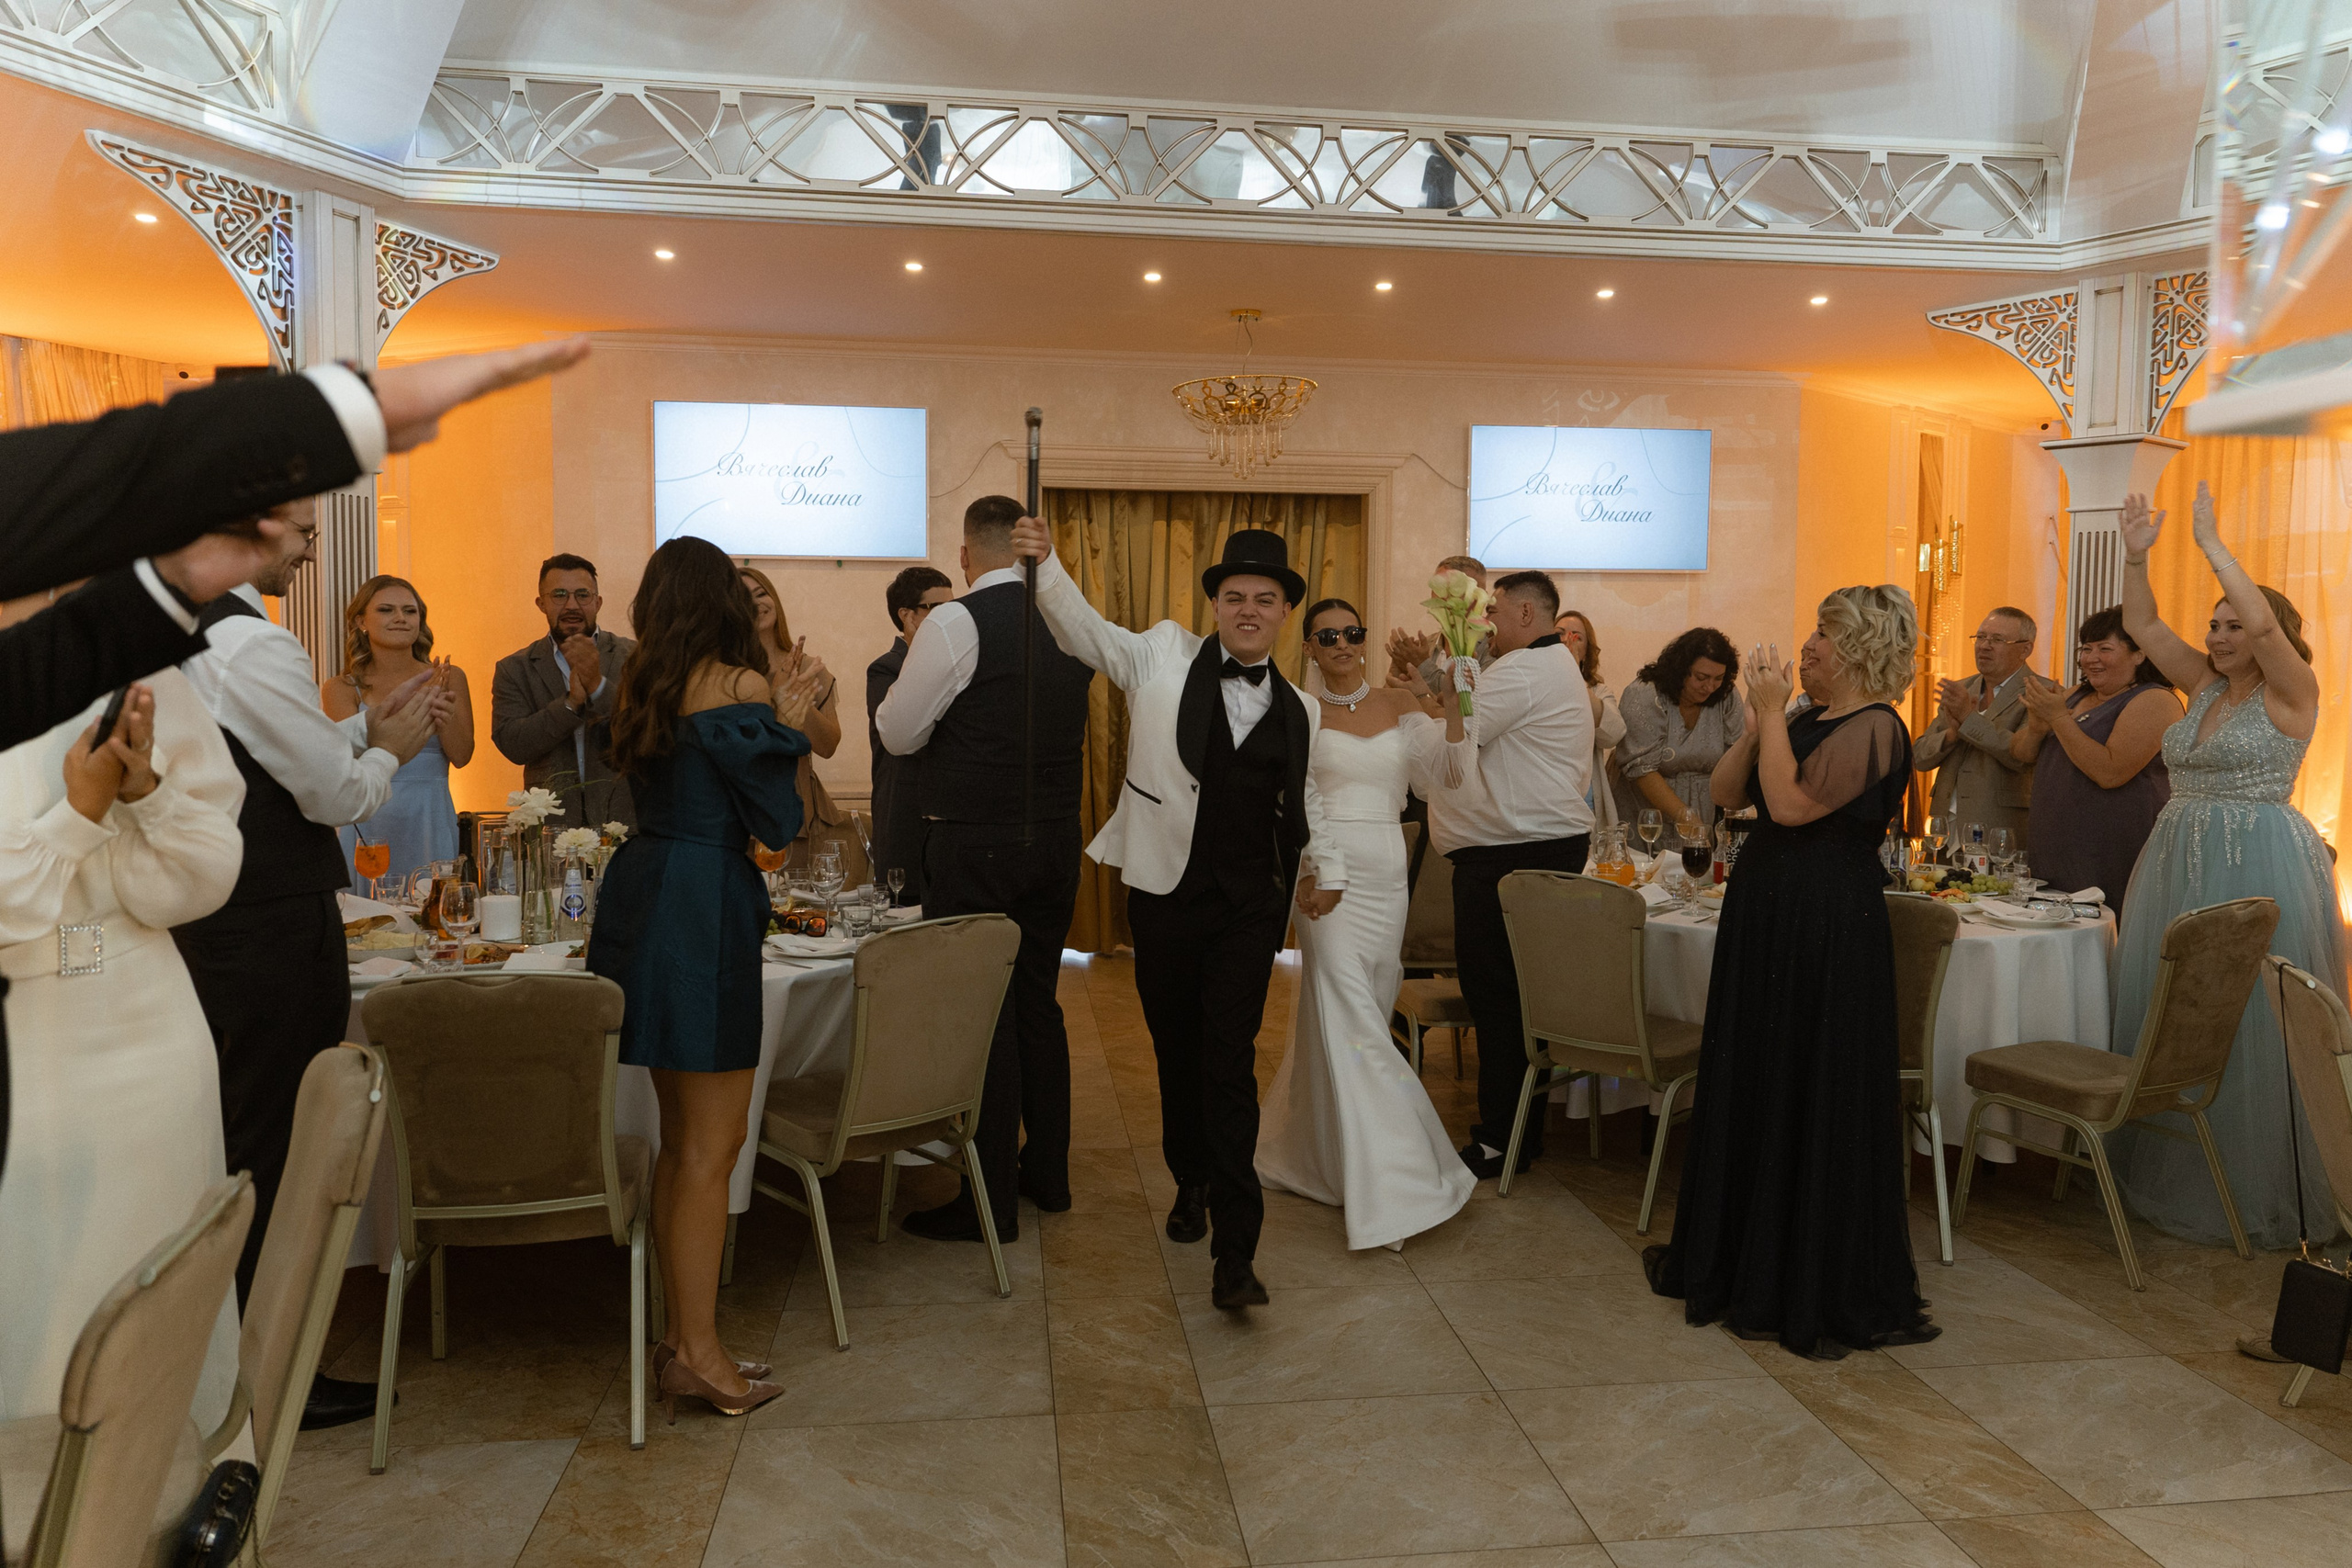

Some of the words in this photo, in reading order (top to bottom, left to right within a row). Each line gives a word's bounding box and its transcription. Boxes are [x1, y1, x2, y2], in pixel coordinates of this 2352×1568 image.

[717, 451, 834, 479] Вячеслав
[781, 480, 867, 507] Диана
[1525, 472, 1629, 496] Вячеслав
[1580, 499, 1656, 523] Диана
